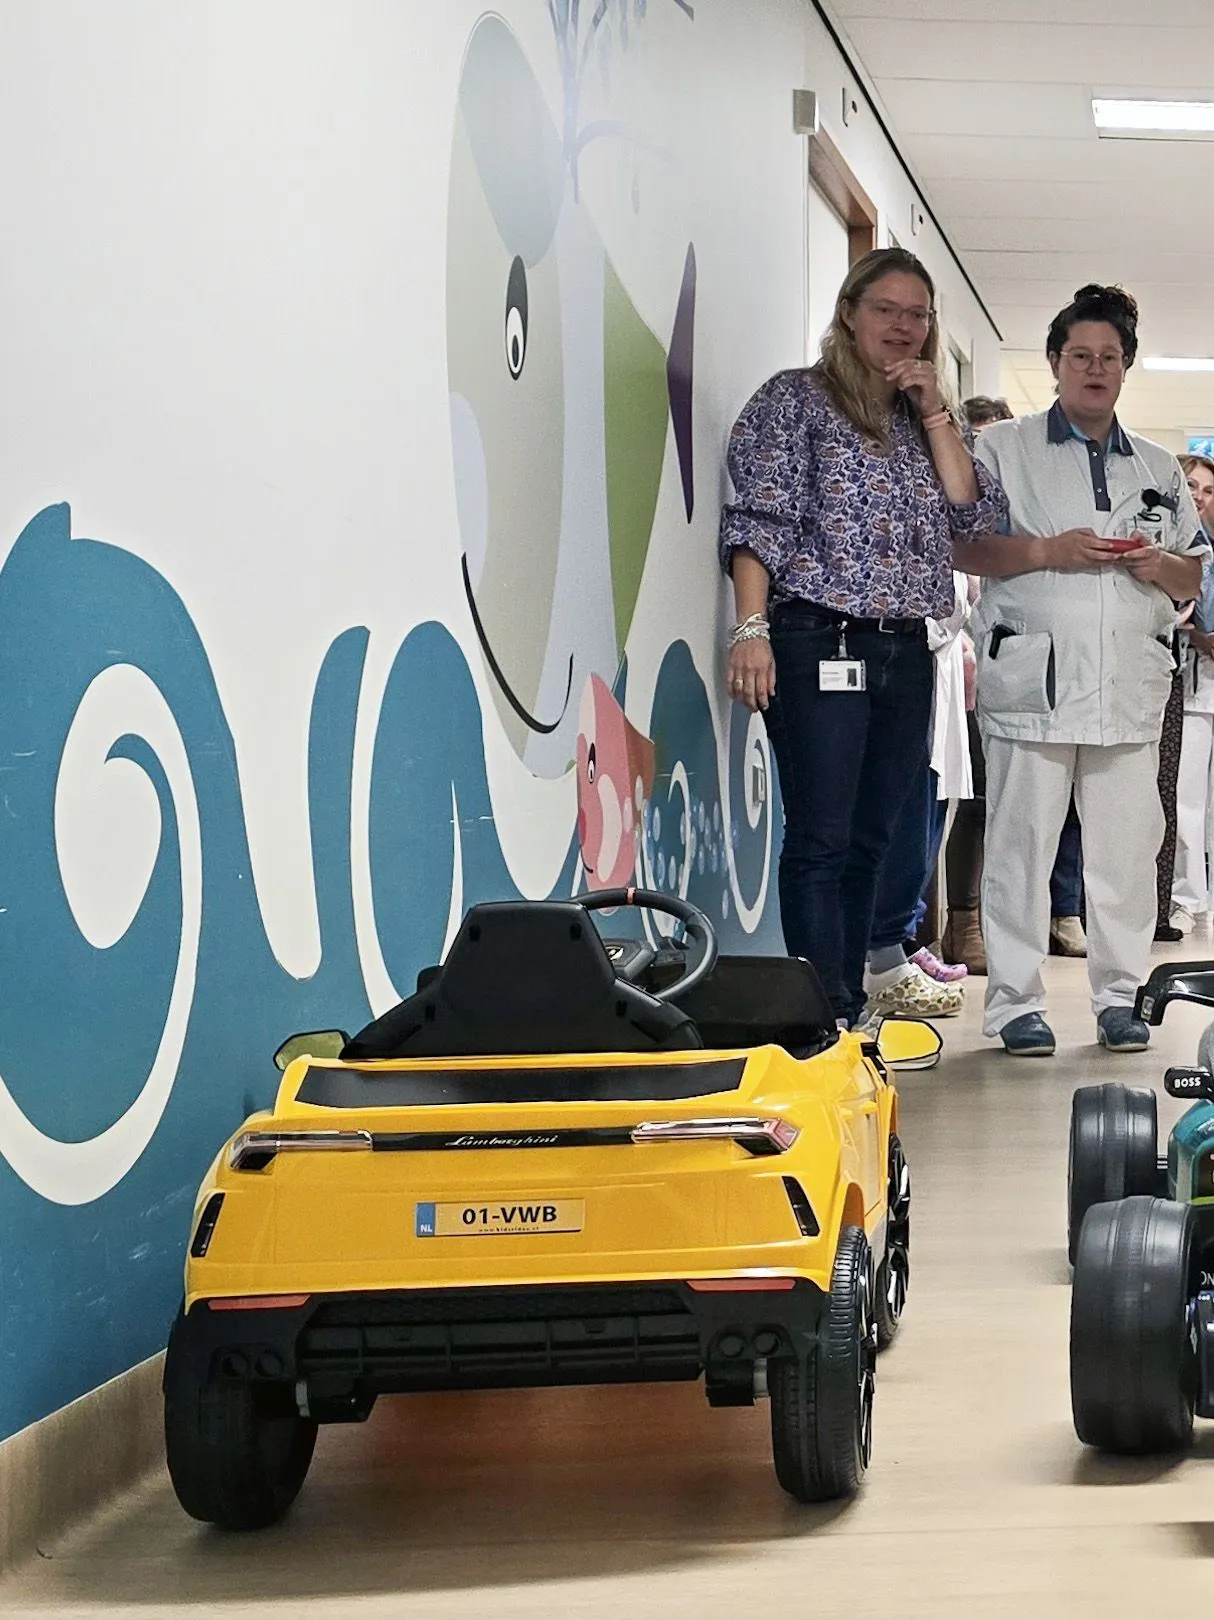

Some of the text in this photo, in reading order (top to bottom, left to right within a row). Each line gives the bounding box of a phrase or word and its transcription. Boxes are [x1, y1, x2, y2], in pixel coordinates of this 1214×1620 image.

[1174, 1077, 1201, 1089] BOSS
[445, 1135, 559, 1146] Lamborghini
[462, 1206, 557, 1225] 01-VWB
[420, 1224, 433, 1233] NL
